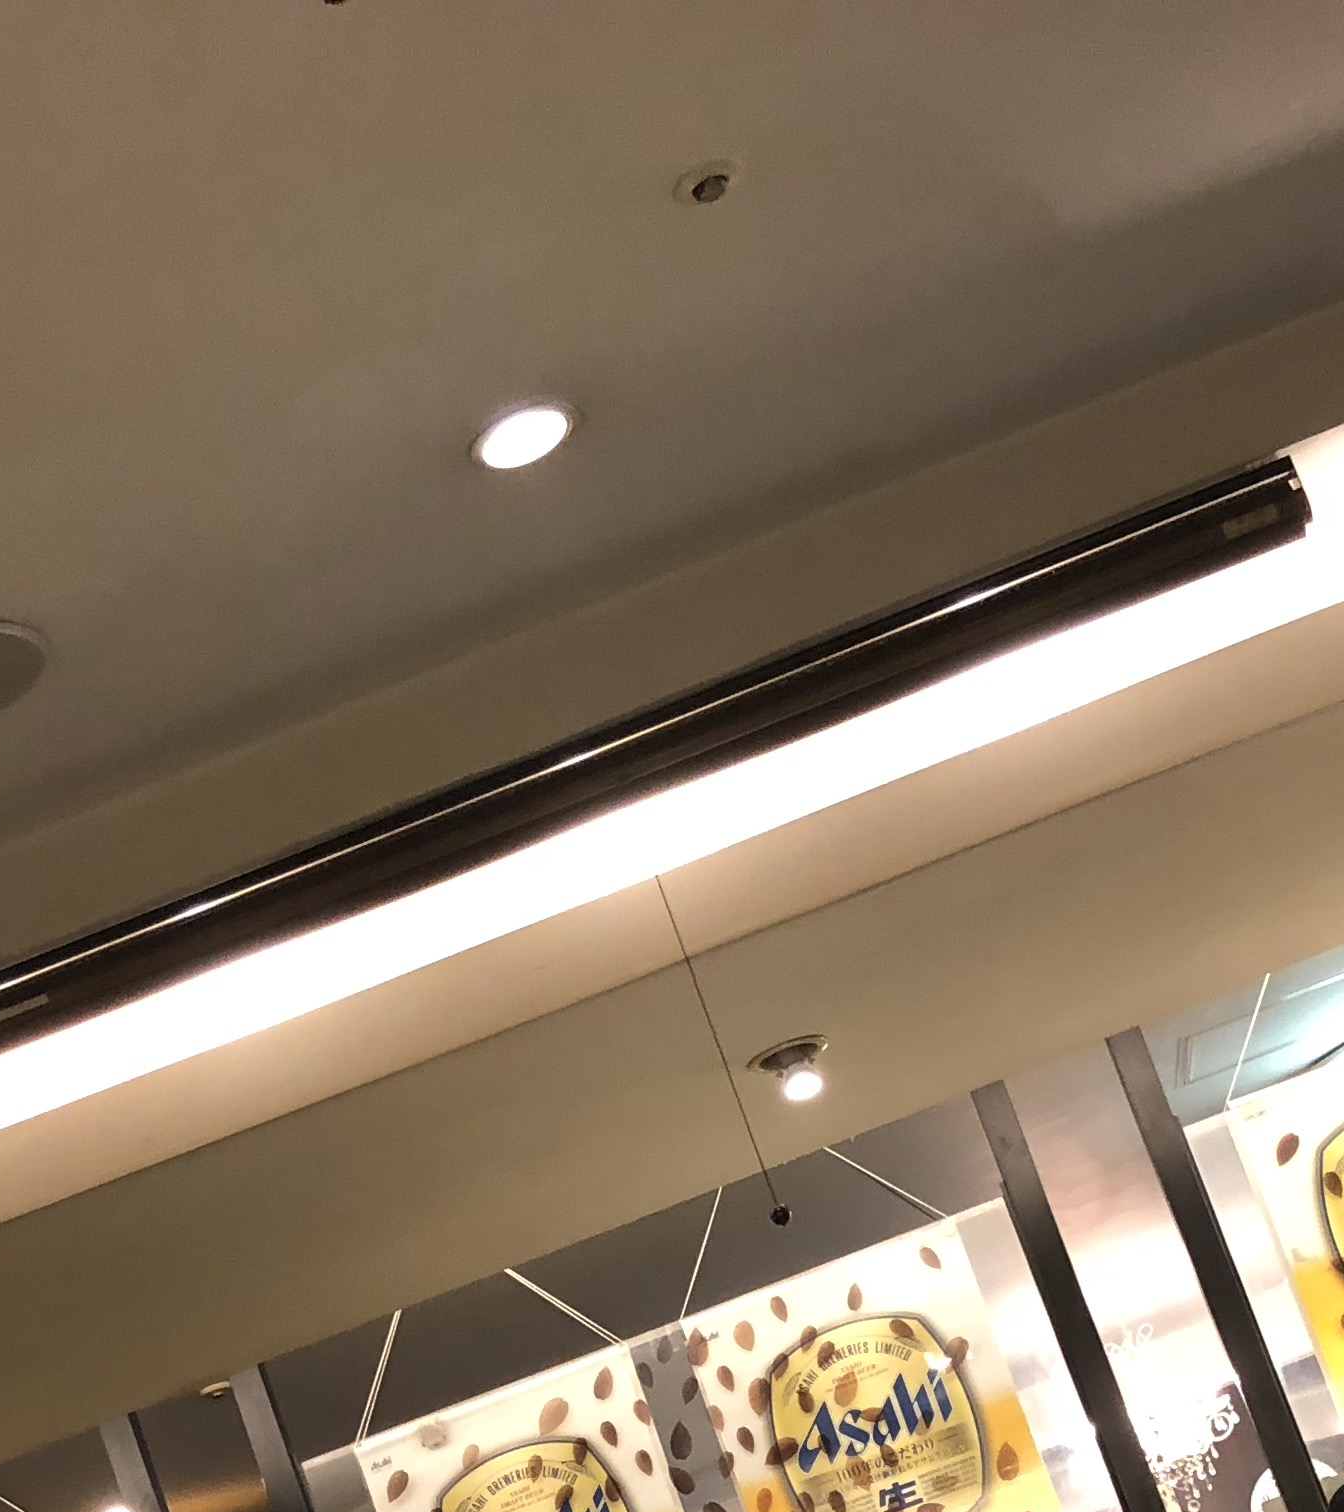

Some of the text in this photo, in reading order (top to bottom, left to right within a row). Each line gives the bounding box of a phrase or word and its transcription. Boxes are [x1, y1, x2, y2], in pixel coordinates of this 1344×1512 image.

[821, 1341, 869, 1372] BREWERIES
[874, 1341, 913, 1362] LIMITED
[797, 1367, 953, 1474] Asahi
[486, 1466, 538, 1496] BREWERIES
[542, 1465, 578, 1486] LIMITED
